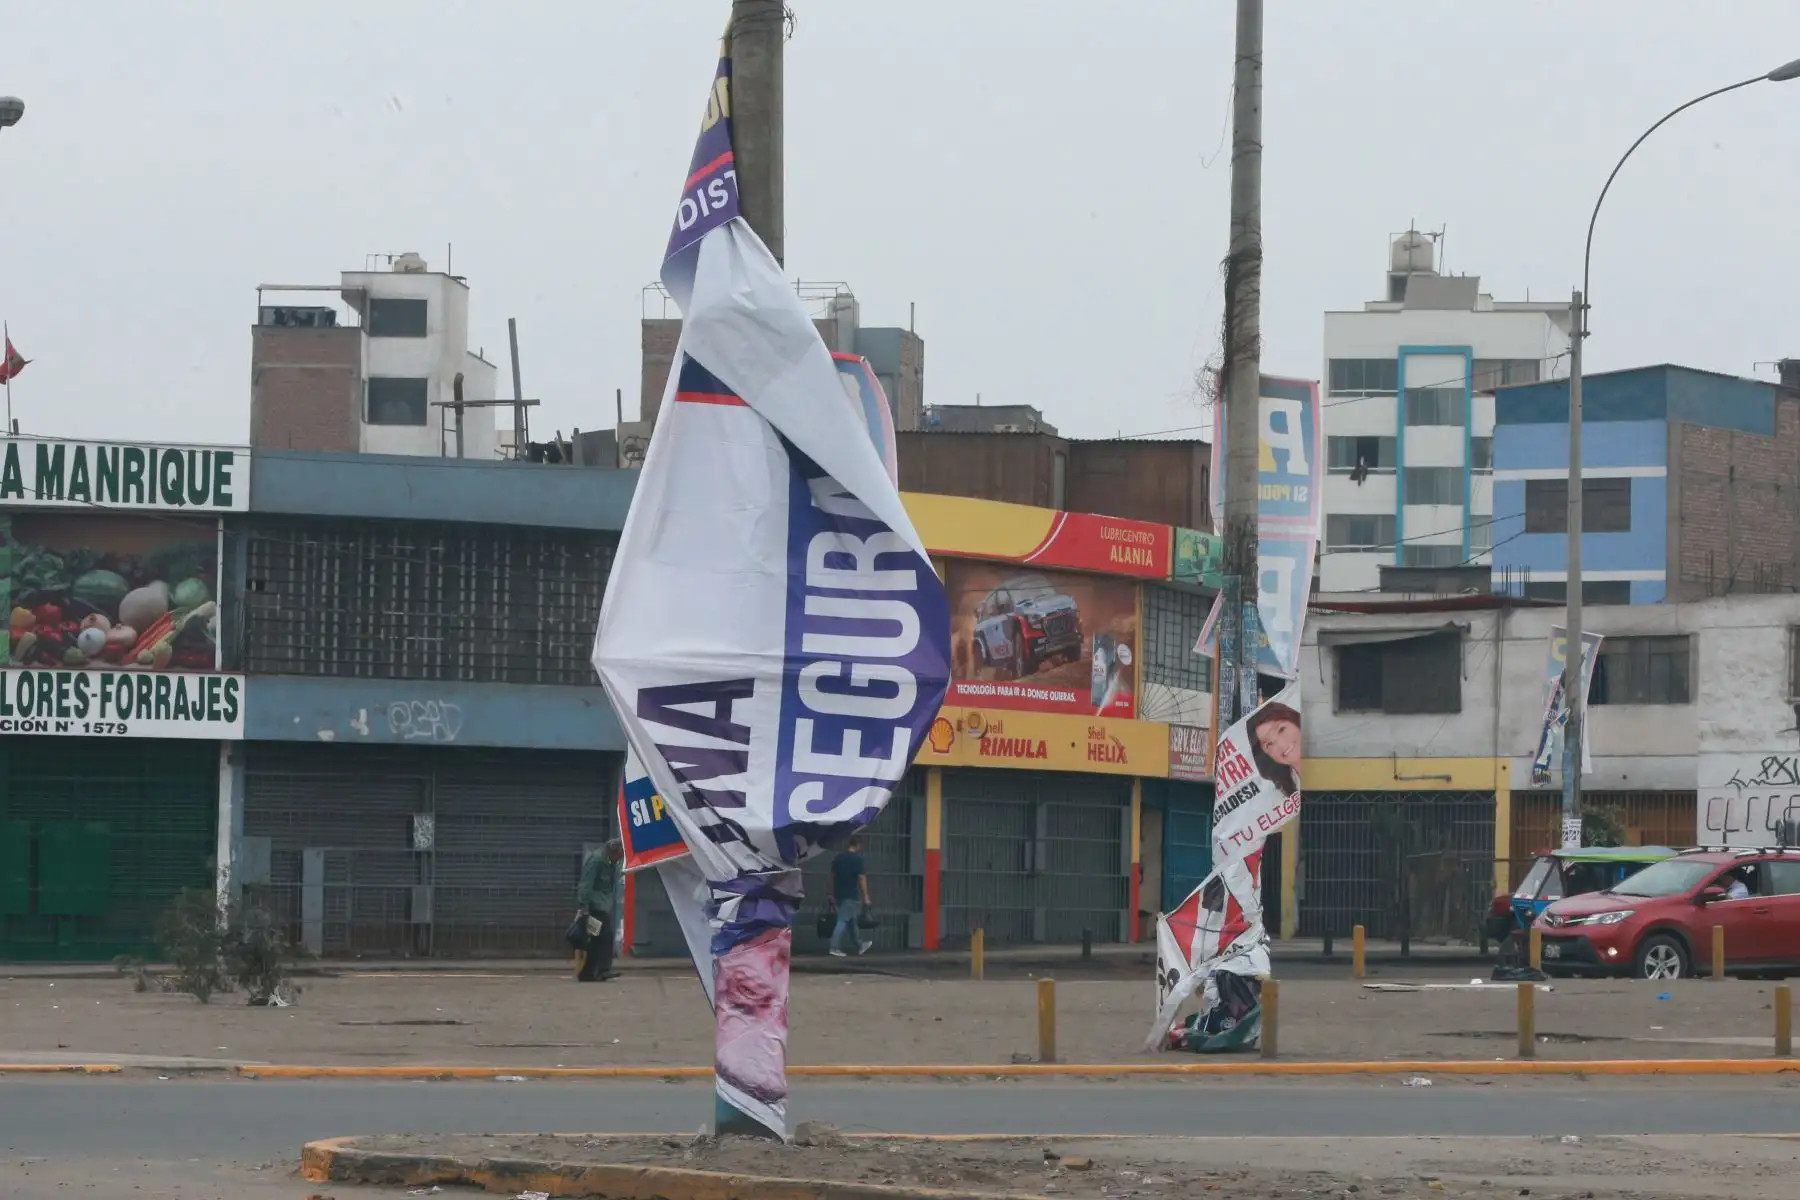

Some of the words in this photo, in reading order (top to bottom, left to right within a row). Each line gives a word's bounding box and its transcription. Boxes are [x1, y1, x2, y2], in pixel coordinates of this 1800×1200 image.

[36, 443, 234, 507] MANRIQUE
[1100, 525, 1155, 545] LUBRICENTRO
[1110, 545, 1154, 568] ALANIA
[956, 683, 996, 695] TECNOLOGÍA
[1021, 688, 1026, 697] A
[1027, 688, 1049, 700] DONDE
[0, 716, 48, 732] CIÓN
[82, 722, 128, 735] 1579
[1088, 726, 1106, 740] Shell
[979, 737, 1048, 760] RIMULA
[1087, 742, 1128, 765] HELIX
[630, 798, 651, 827] SI
[1228, 825, 1254, 847] TU
